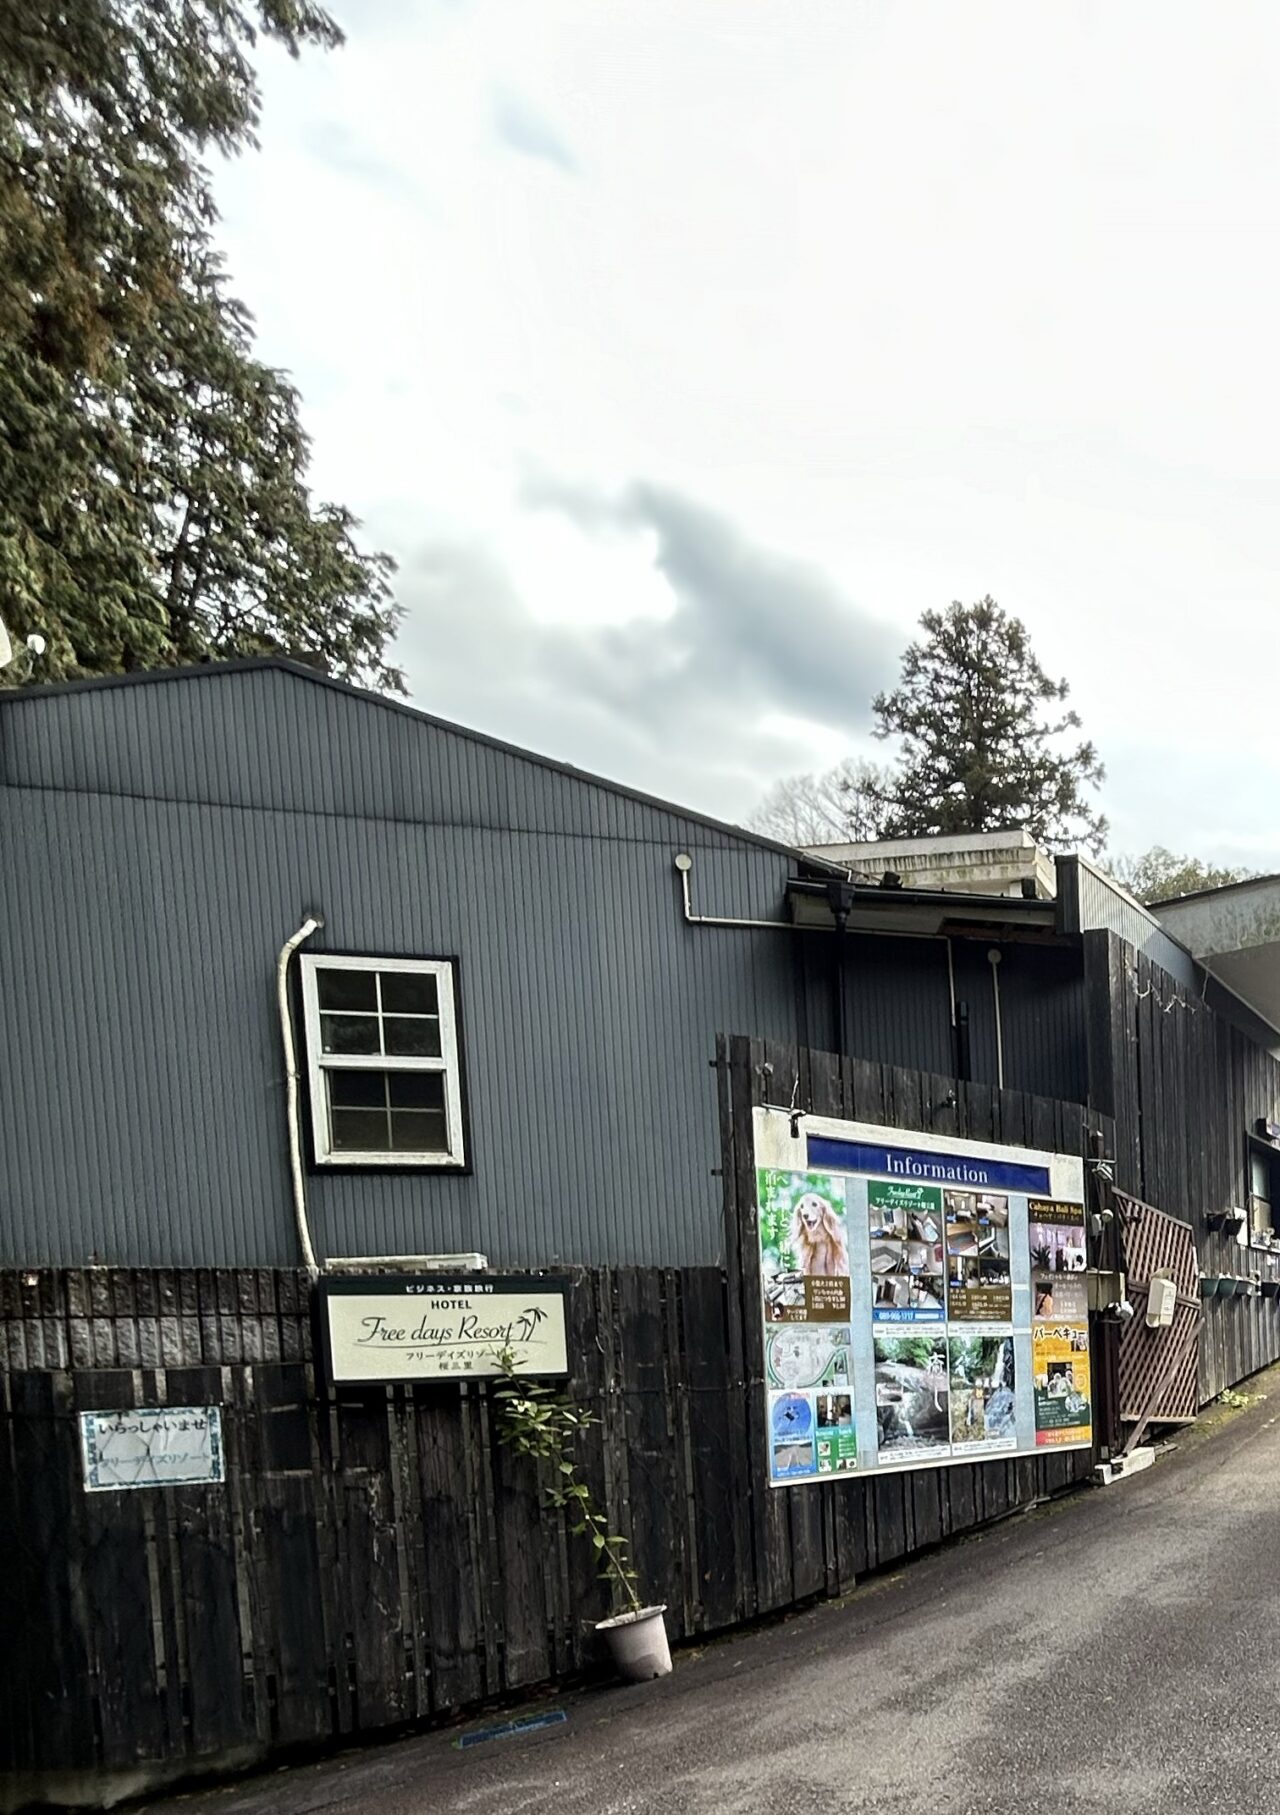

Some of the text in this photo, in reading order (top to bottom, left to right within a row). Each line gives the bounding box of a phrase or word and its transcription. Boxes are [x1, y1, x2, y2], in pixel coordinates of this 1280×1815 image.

[885, 1153, 989, 1184] Information
[431, 1300, 472, 1310] HOTEL
[357, 1315, 514, 1346] Free days Resort
[1033, 1326, 1087, 1340] バーベキュー
[405, 1350, 513, 1361] フリーデイズリゾー
[438, 1361, 474, 1371] 桜三里
[98, 1418, 208, 1435] いらっしゃいませ
